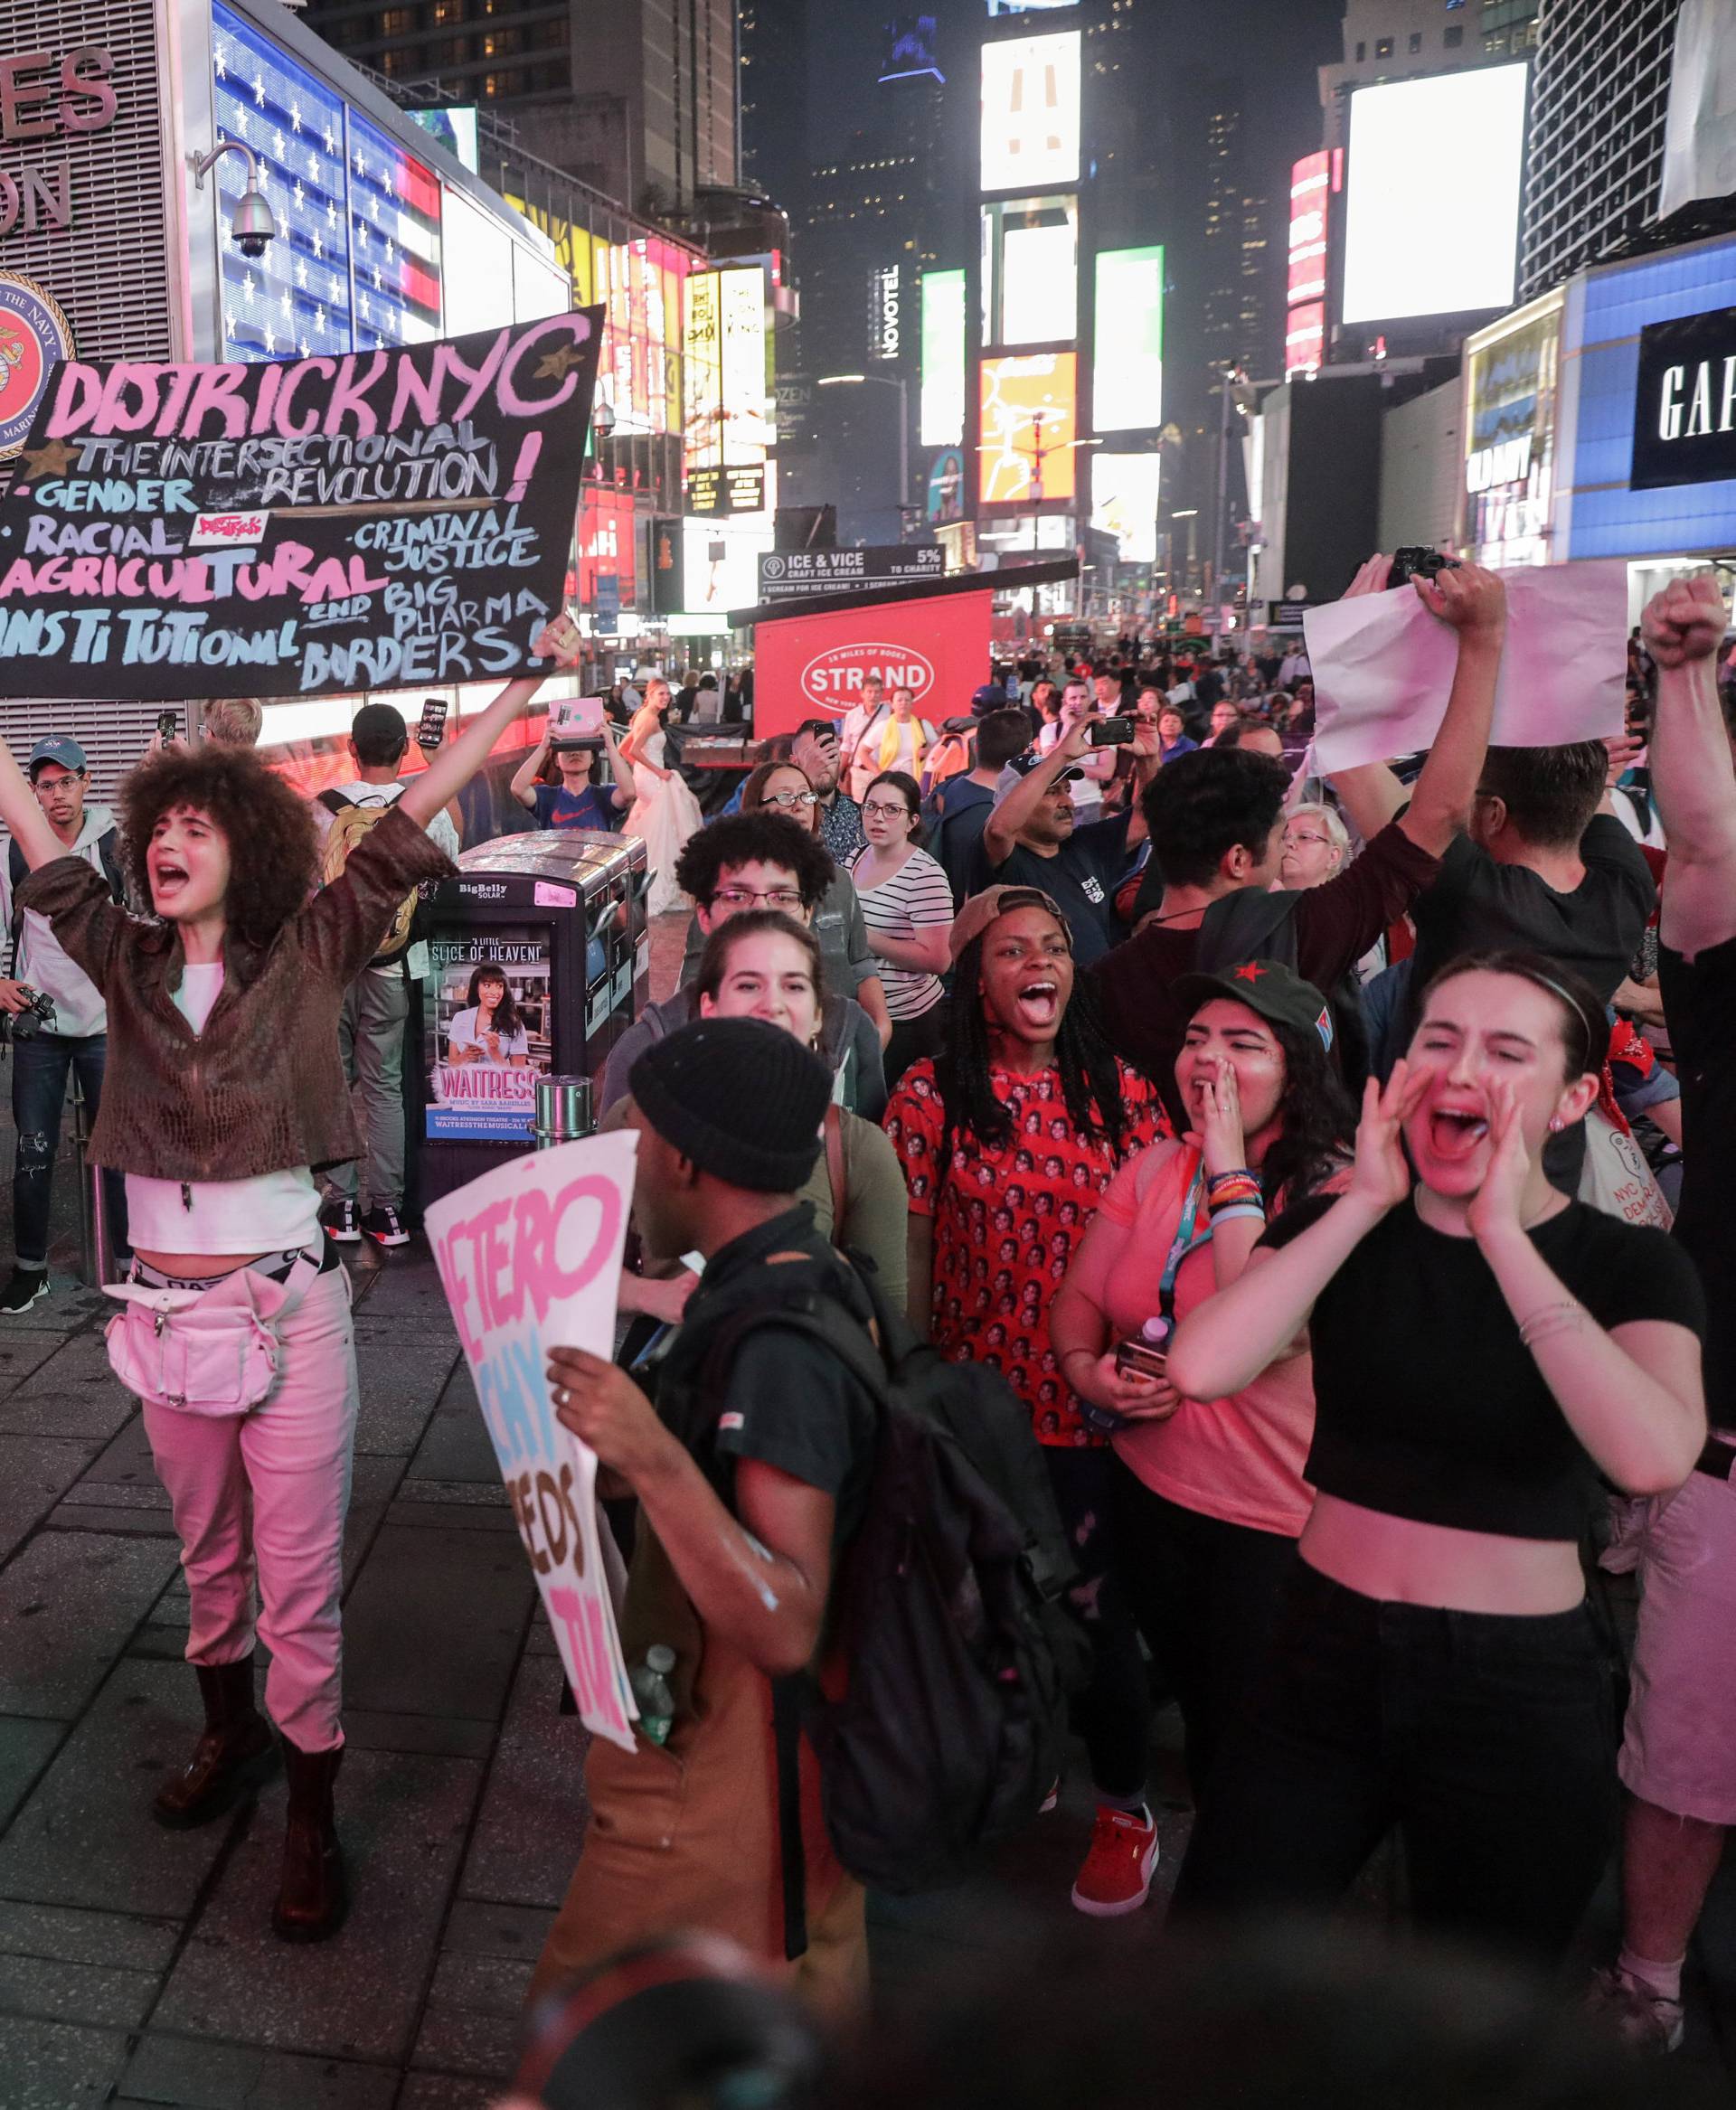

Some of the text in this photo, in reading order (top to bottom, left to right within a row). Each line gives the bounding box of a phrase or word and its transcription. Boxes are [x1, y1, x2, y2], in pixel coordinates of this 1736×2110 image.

[5, 290, 57, 347] THE NAVY
[881, 264, 899, 359] NOVOTEL
[72, 420, 492, 479] THE INTERSECTIONAL
[261, 442, 497, 505] REVOLUTION
[34, 478, 200, 513] GENDER
[24, 513, 184, 558] RACIAL
[354, 504, 535, 550] CRIMINAL
[0, 540, 390, 603] AGRICULTURAL
[383, 533, 541, 574] JUSTICE
[788, 549, 941, 569] ICE & VICE 5%
[788, 563, 941, 579] CRAFT ICE CREAM TO CHARITY
[307, 594, 372, 620] END
[383, 576, 458, 615] BIG
[769, 585, 796, 594] SCREAM
[797, 585, 810, 593] FOR
[393, 588, 550, 642] PHARMA
[840, 649, 865, 659] MILES
[867, 647, 878, 655] OF
[459, 883, 507, 894] BigBelly
[431, 947, 466, 961] SLICE
[470, 947, 485, 961] OF
[1614, 1182, 1638, 1203] NYC
